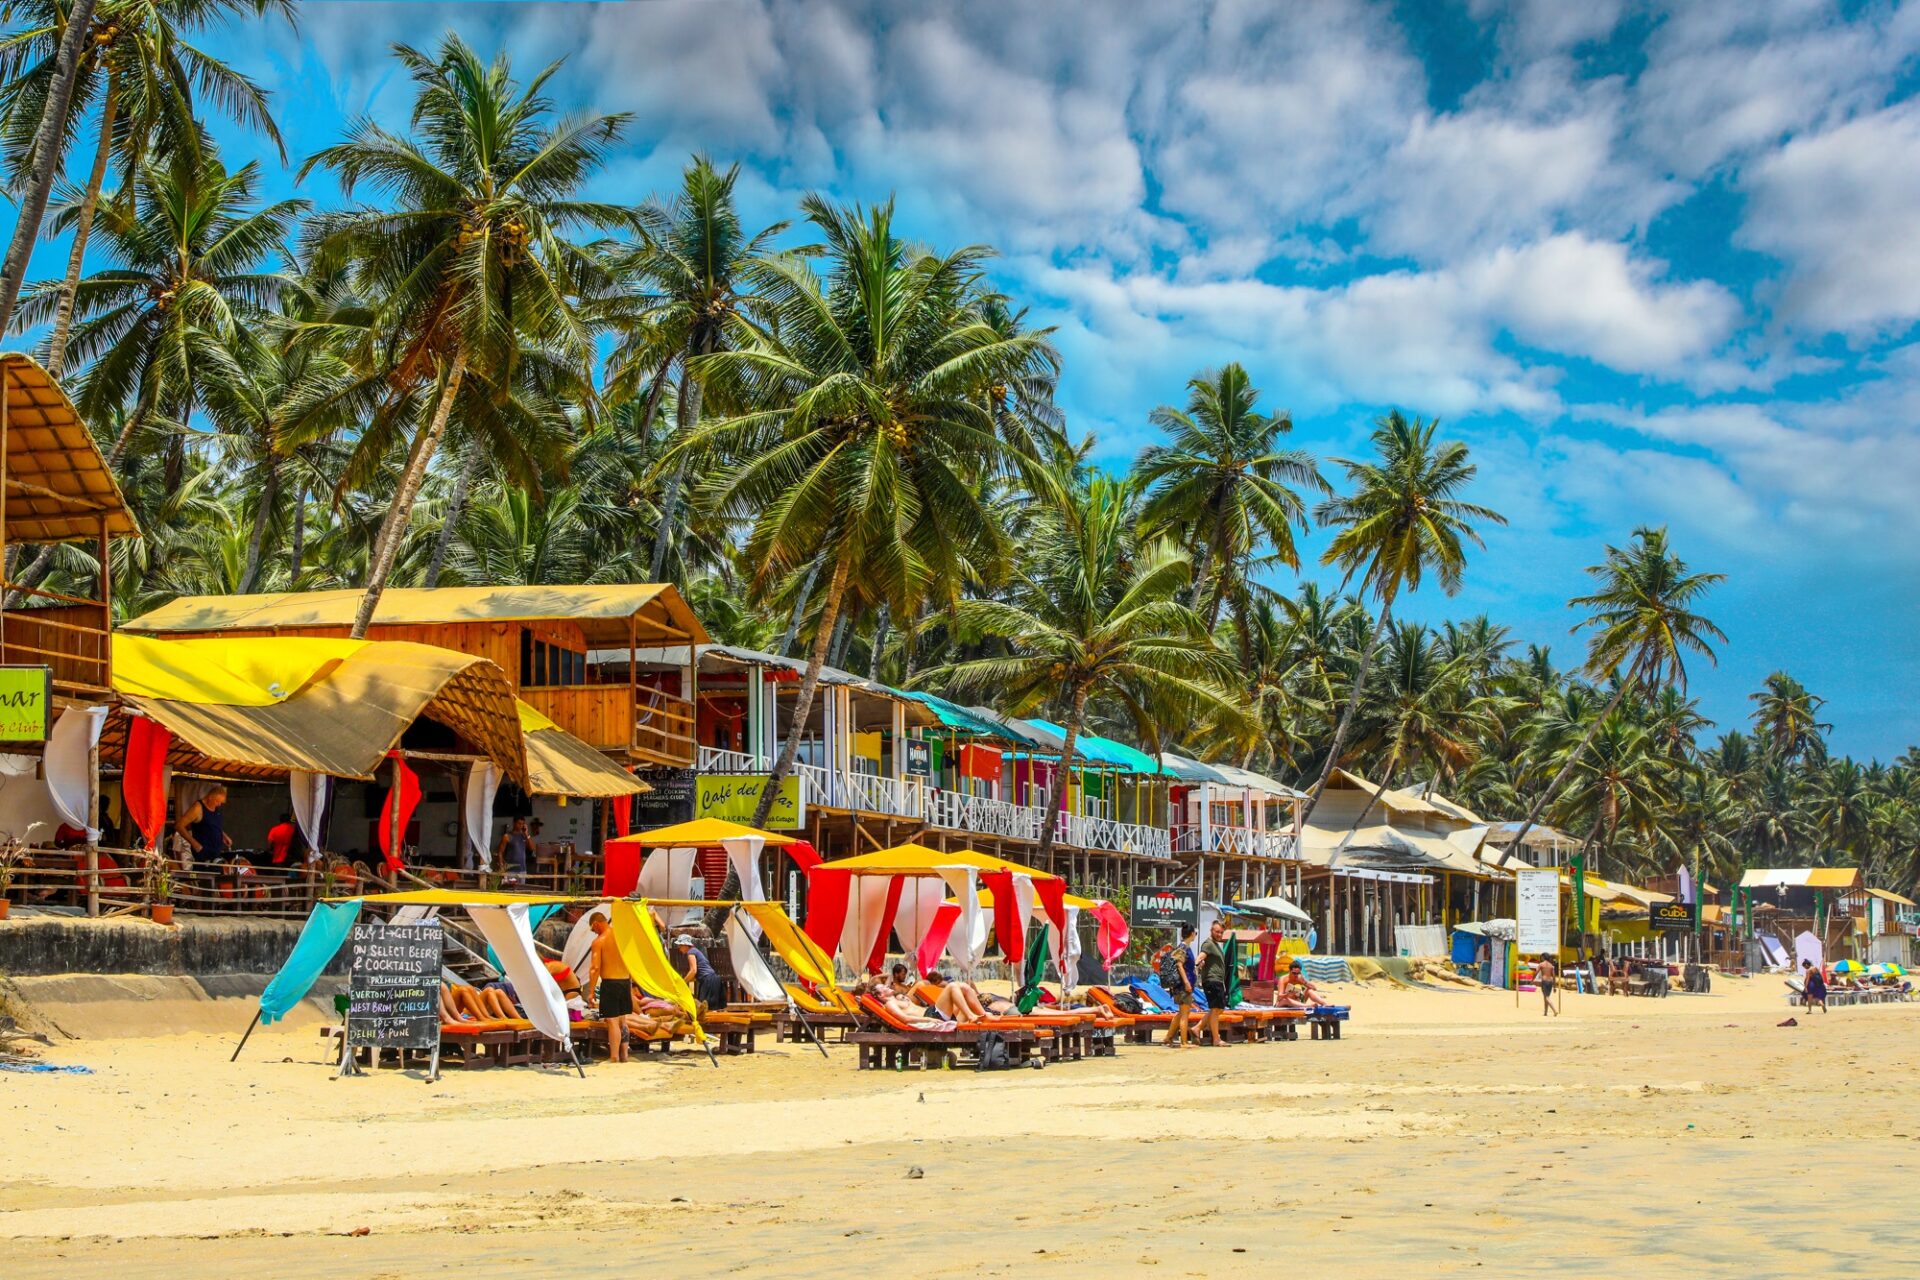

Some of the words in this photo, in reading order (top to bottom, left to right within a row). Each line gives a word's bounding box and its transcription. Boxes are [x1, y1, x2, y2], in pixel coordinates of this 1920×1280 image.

[702, 784, 731, 809] Café
[737, 783, 759, 795] del
[1136, 895, 1193, 911] HAVANA
[1660, 908, 1687, 918] Cuba
[354, 926, 376, 942] BUY
[414, 926, 421, 941] 1
[423, 928, 443, 940] FREE
[353, 944, 366, 955] ON
[370, 944, 404, 957] SELECT
[365, 959, 422, 973] COCKTAILS
[351, 990, 385, 1000] EVERTON
[394, 989, 425, 998] WATFORD
[351, 1003, 370, 1013] WEST
[371, 1002, 391, 1013] BROM
[399, 1001, 430, 1011] CHELSEA
[350, 1030, 376, 1040] DELHI
[389, 1028, 409, 1038] PUNE
